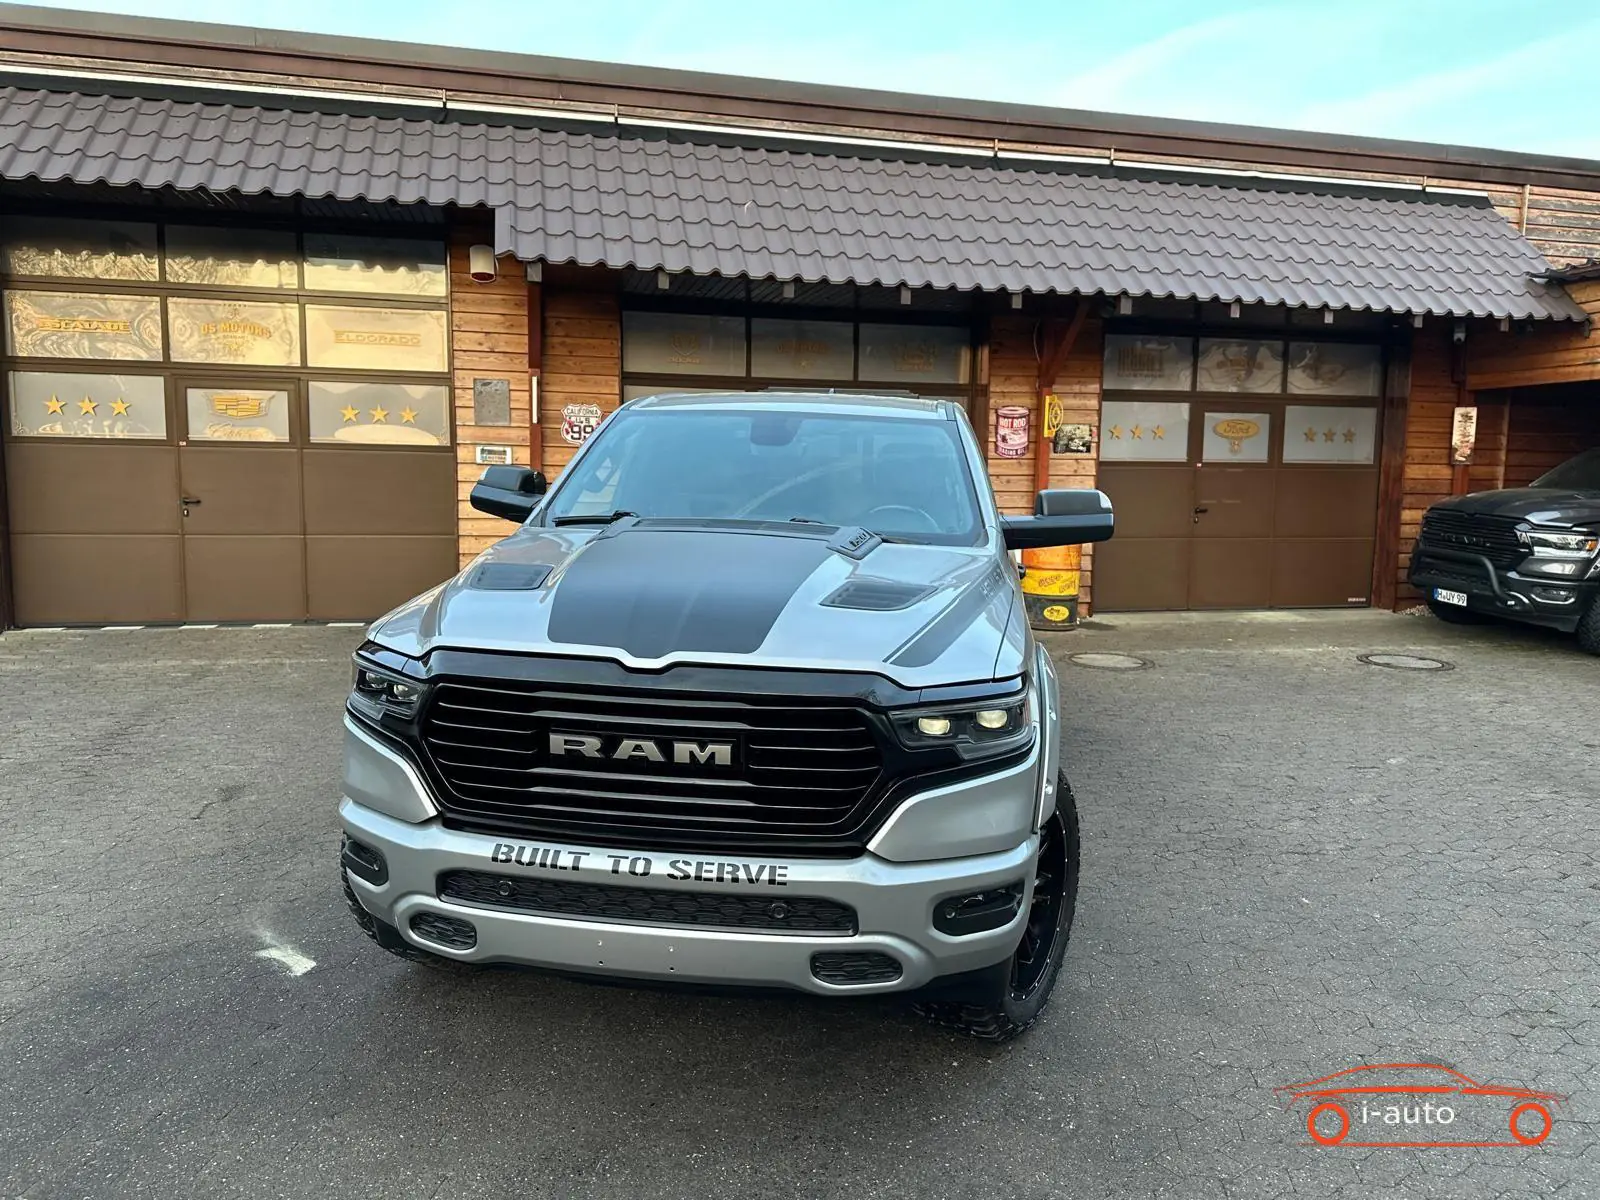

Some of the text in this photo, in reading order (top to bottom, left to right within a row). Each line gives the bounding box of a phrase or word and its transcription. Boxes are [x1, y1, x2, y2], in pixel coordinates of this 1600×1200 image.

[221, 321, 271, 339] MOTORS
[334, 331, 421, 346] ELDORADO
[999, 416, 1026, 428] HOT ROD
[549, 732, 732, 765] RAM
[491, 843, 788, 886] BUILT TO SERVE
